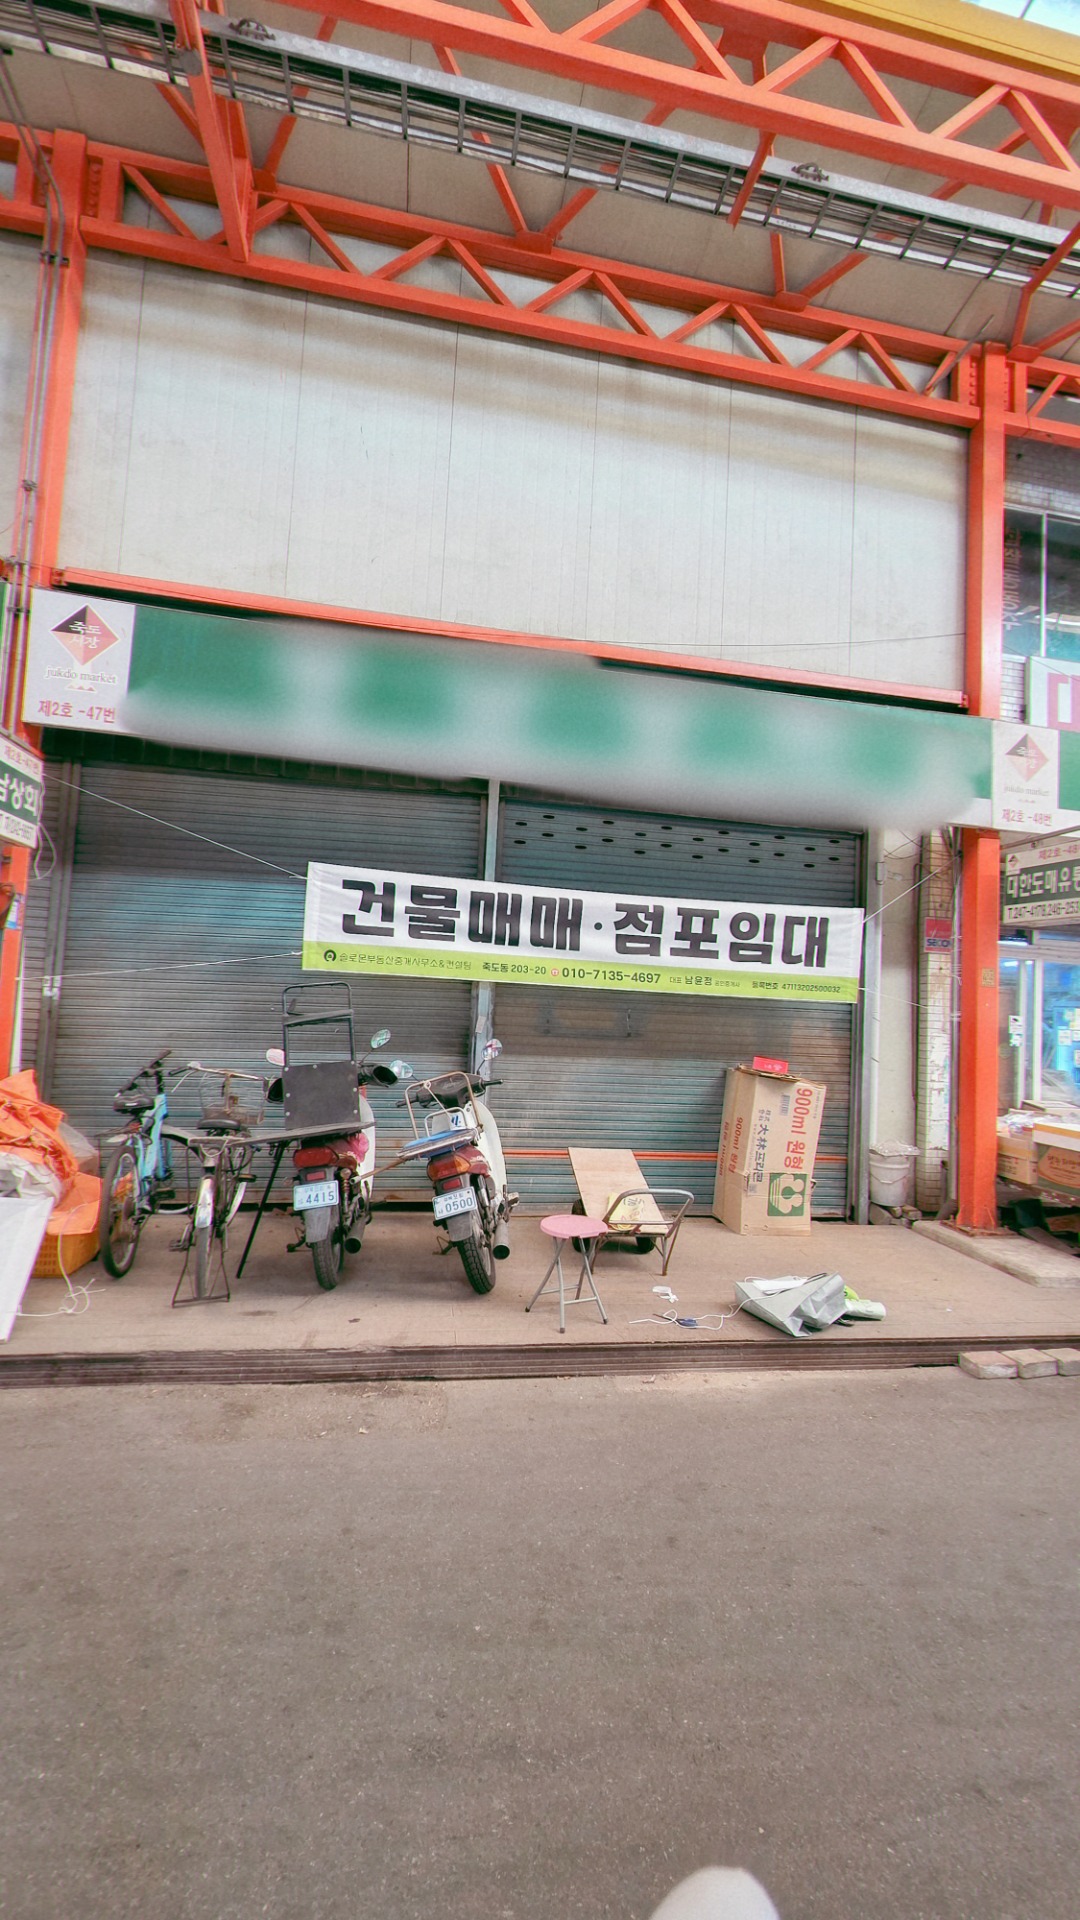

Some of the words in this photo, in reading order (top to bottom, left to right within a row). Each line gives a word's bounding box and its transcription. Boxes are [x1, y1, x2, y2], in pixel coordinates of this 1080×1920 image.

[68, 620, 102, 635] 죽도
[38, 700, 73, 718] 제2호
[78, 705, 116, 723] -47번
[482, 961, 509, 973] 죽도동
[511, 964, 547, 975] 203-20
[562, 966, 661, 984] 010-7135-4697
[684, 975, 713, 986] 남윤정
[790, 1088, 813, 1135] 900ml
[784, 1140, 806, 1170] 원형
[305, 1189, 335, 1205] 4415
[445, 1196, 473, 1215] 0500
